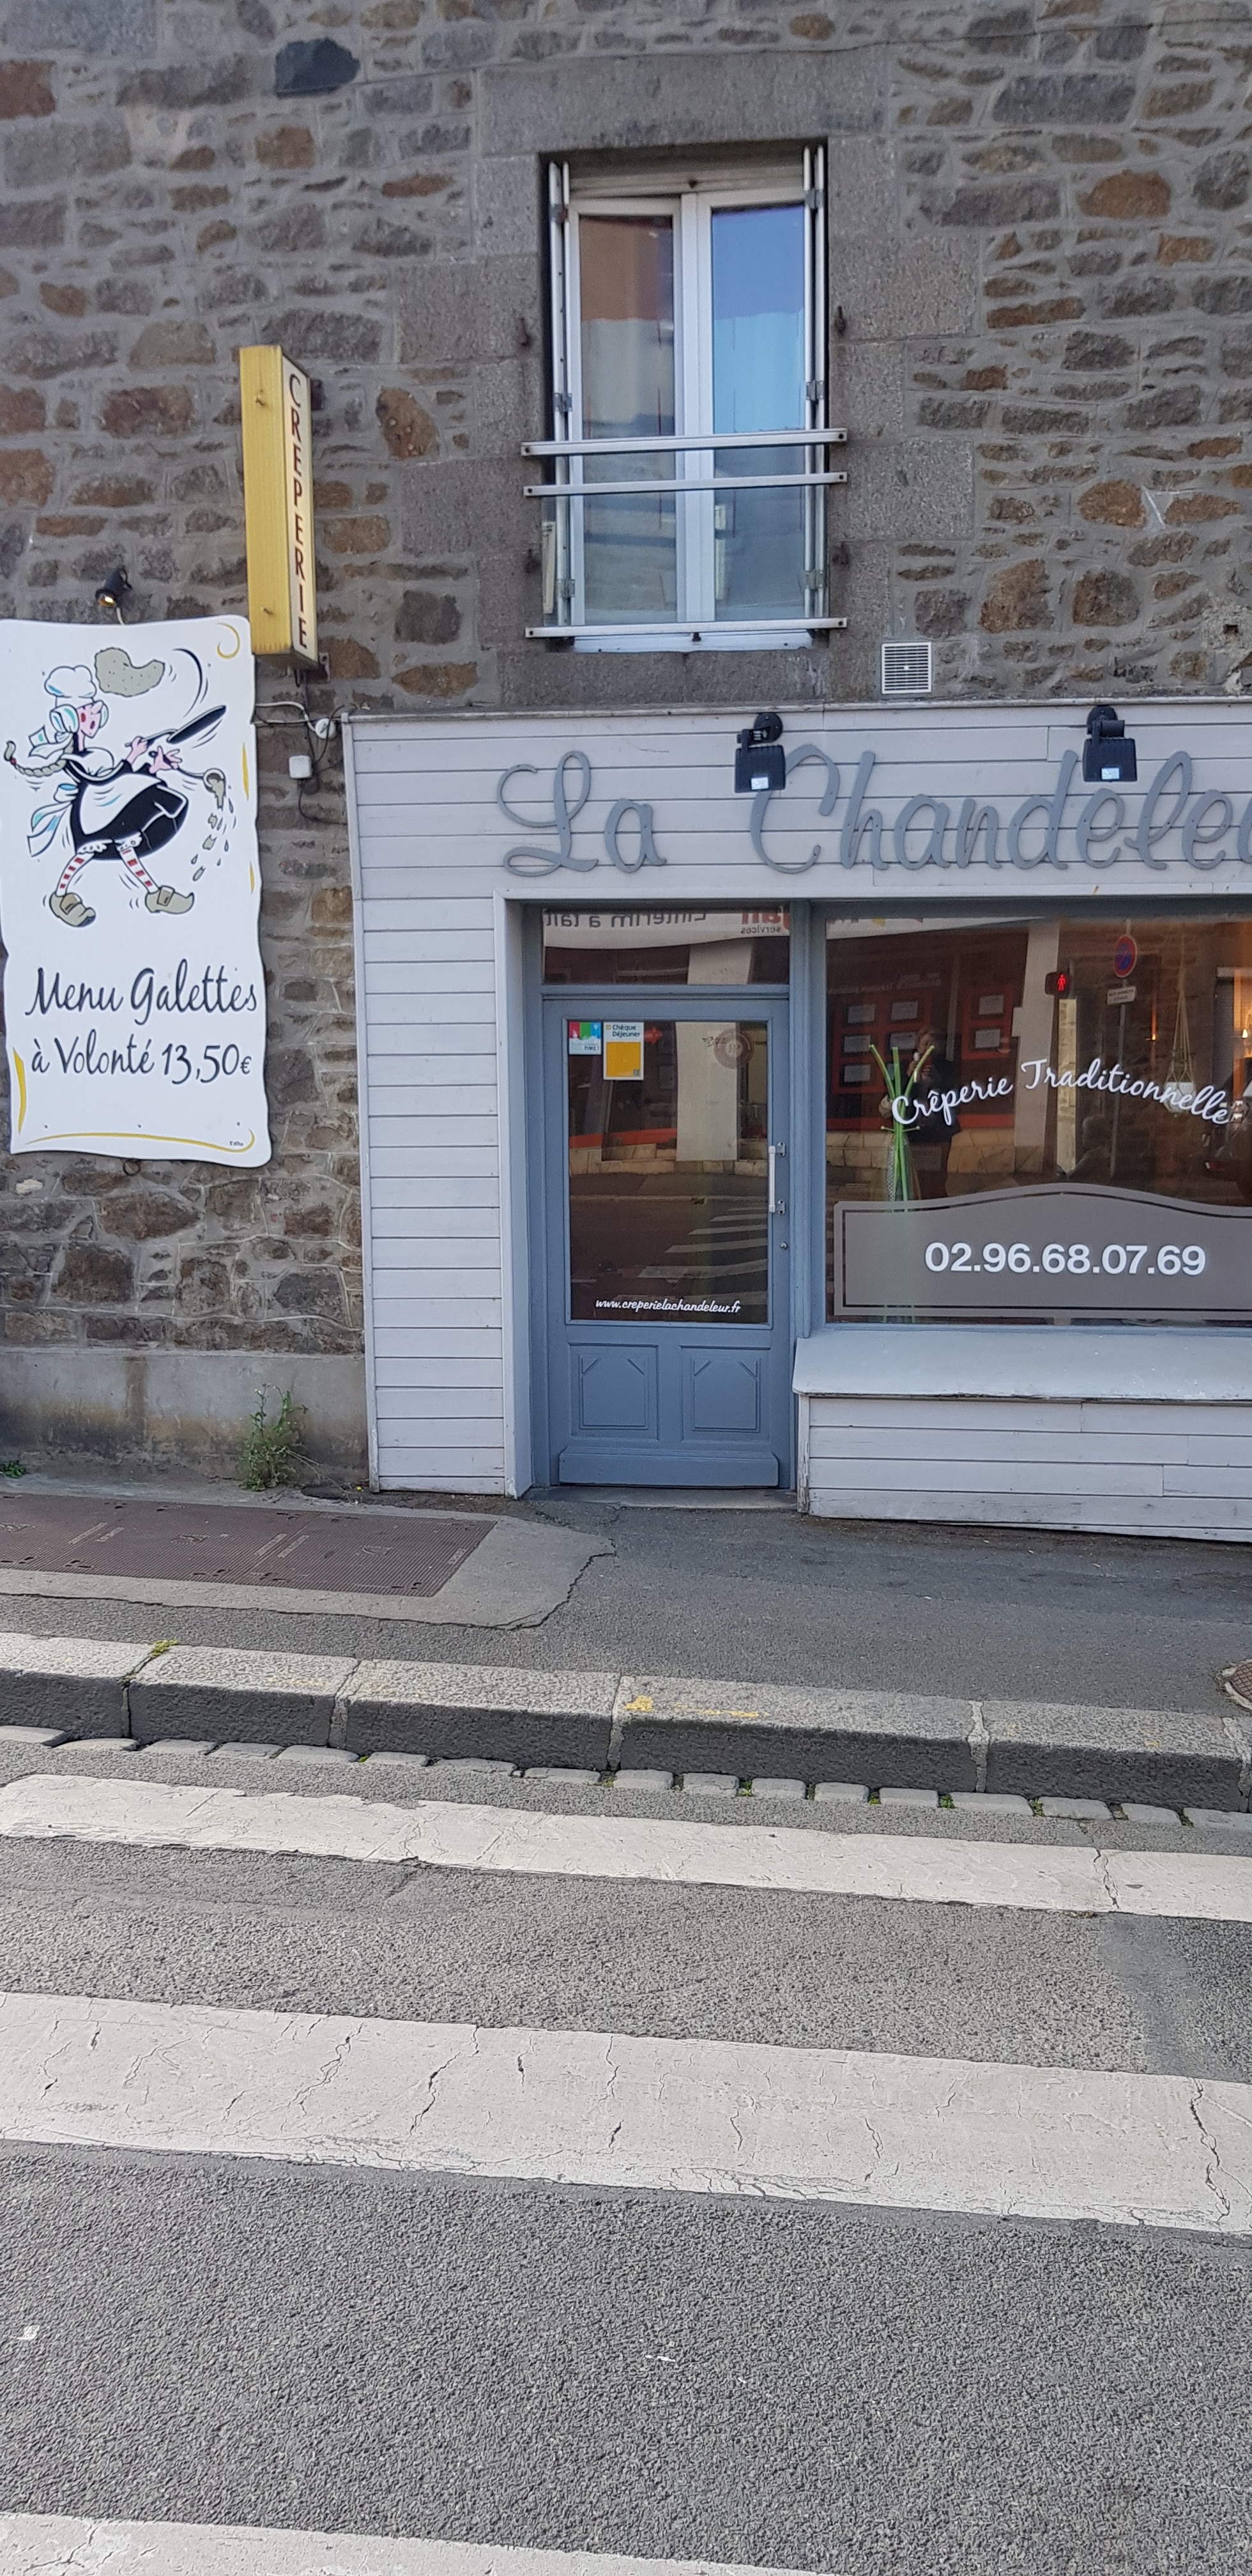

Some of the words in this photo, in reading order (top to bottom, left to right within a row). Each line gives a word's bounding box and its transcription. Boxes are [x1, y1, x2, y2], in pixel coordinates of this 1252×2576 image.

[289, 373, 308, 650] CREPERIE
[496, 749, 668, 878] La
[25, 967, 124, 1016] Menu
[130, 958, 257, 1025] Galettes
[31, 1038, 50, 1073] à
[54, 1029, 155, 1075] Volonté
[891, 1075, 1014, 1126] Crêperie
[1020, 1057, 1230, 1125] Traditionnelle
[924, 1241, 1206, 1276] 02.96.68.07.69
[595, 1298, 741, 1314] www.creperielachandeleur.fr
